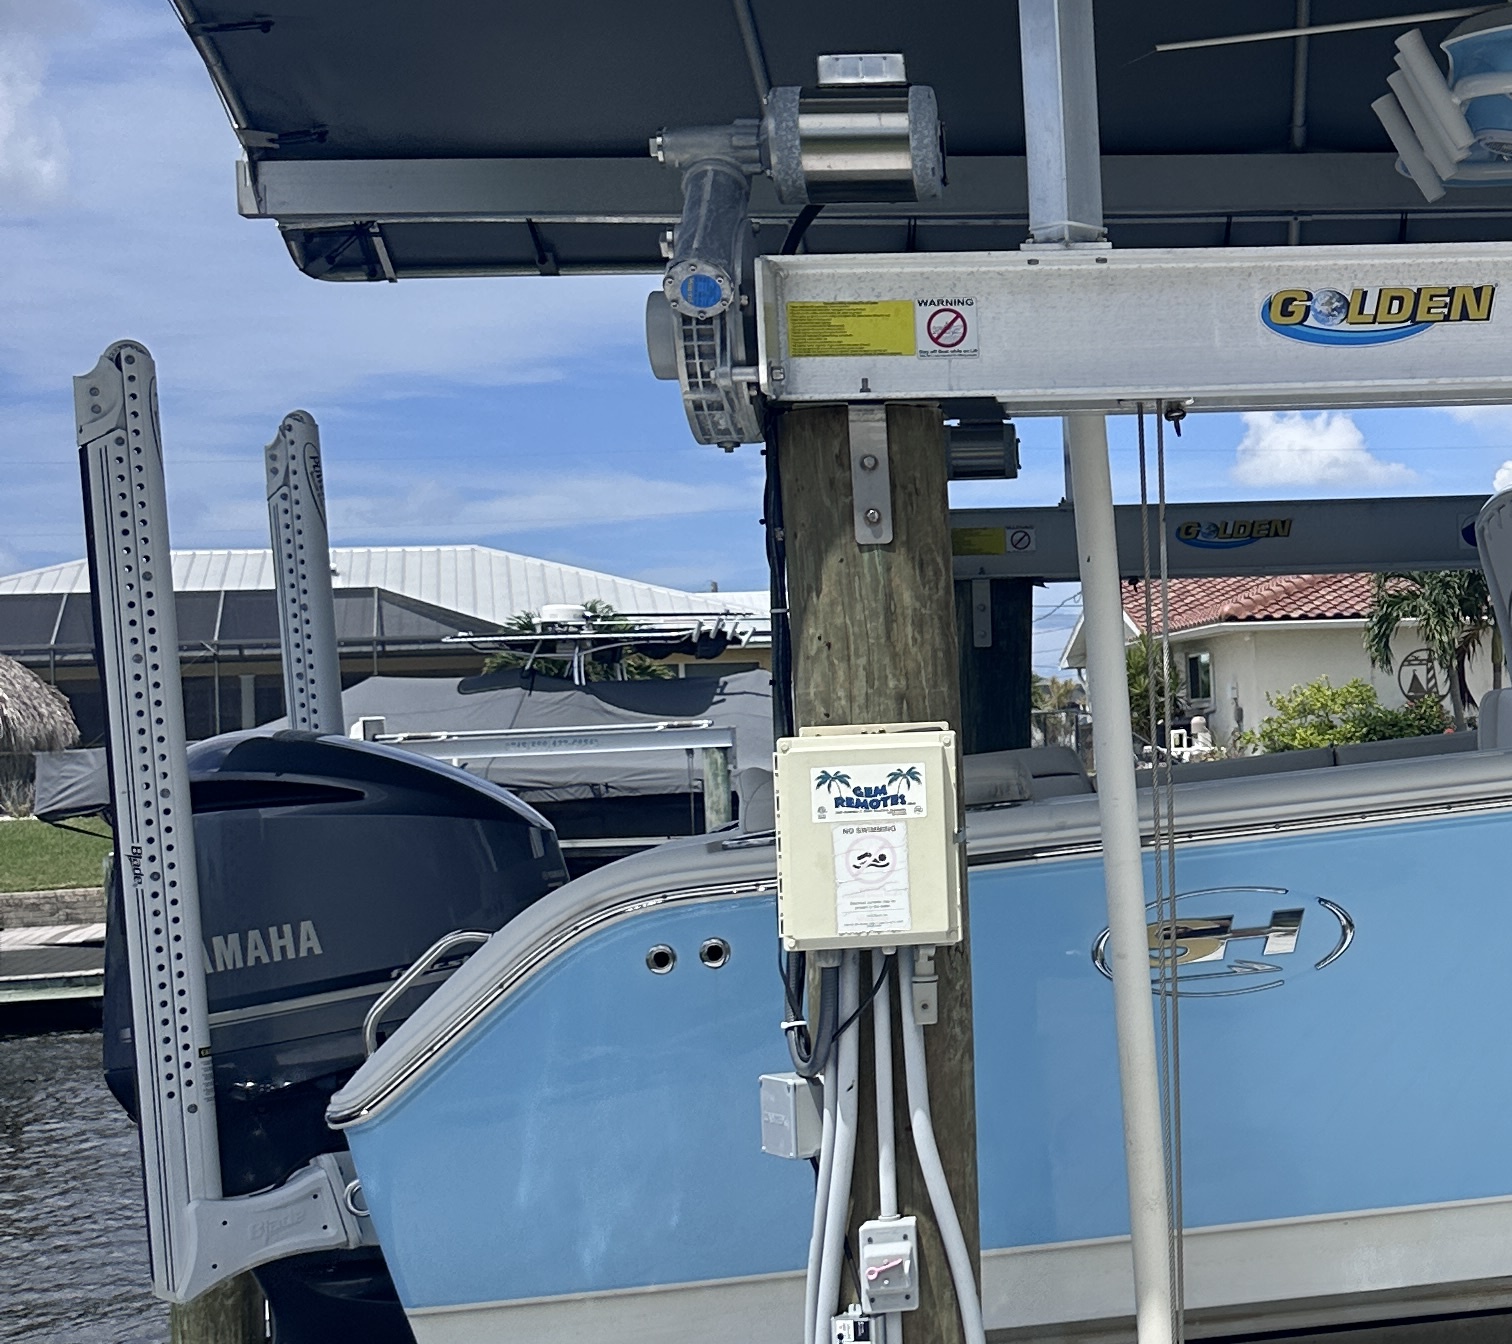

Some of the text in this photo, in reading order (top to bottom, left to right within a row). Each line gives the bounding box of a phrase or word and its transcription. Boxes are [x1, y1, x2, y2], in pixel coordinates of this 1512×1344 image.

[918, 298, 974, 307] WARNING
[1269, 285, 1495, 326] GOLDEN
[1179, 518, 1293, 539] GOLDEN
[834, 793, 907, 809] REMOTES
[852, 784, 888, 797] GEM
[124, 846, 144, 884] Blade
[202, 920, 323, 974] MAHA
